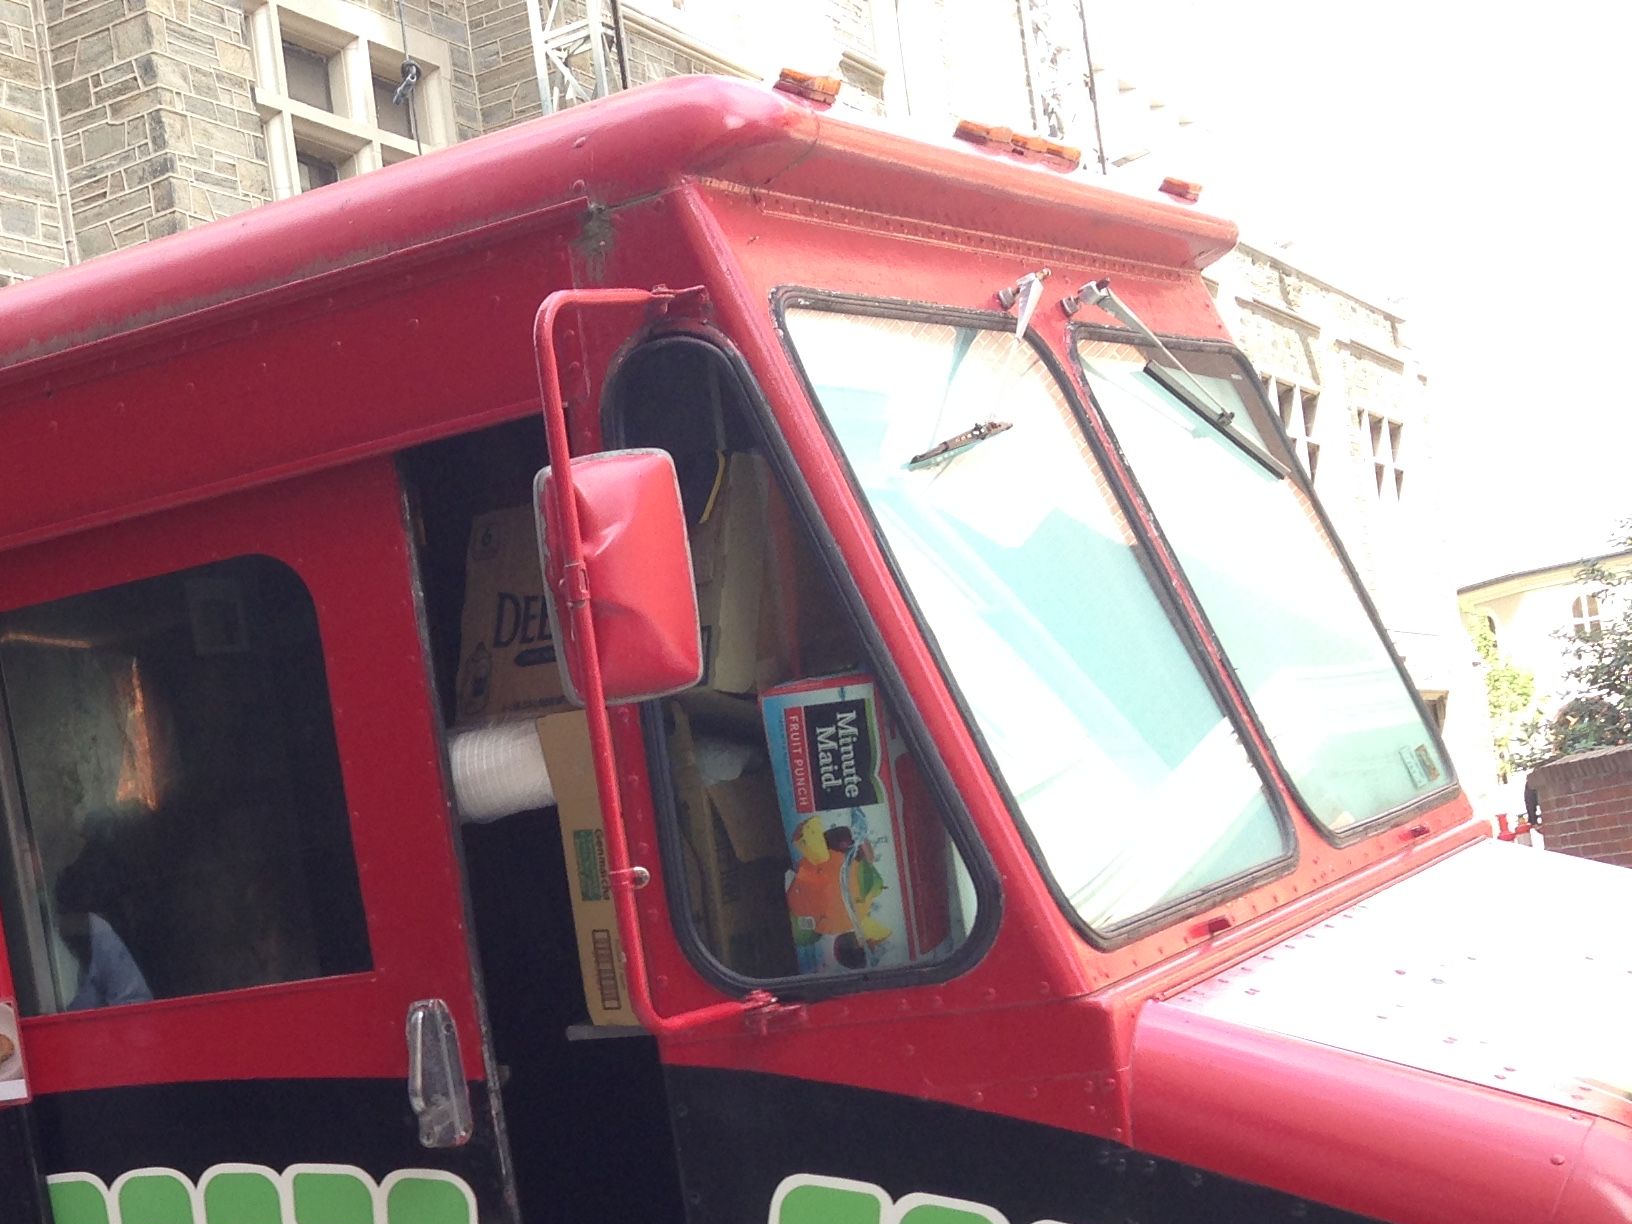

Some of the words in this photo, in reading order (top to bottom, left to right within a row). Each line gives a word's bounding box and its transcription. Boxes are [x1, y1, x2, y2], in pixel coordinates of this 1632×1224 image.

[789, 715, 803, 755] FRUIT
[816, 725, 843, 790] Maid
[836, 710, 863, 798] Minute
[793, 758, 808, 806] PUNCH
[594, 828, 612, 901] Genmaicha
